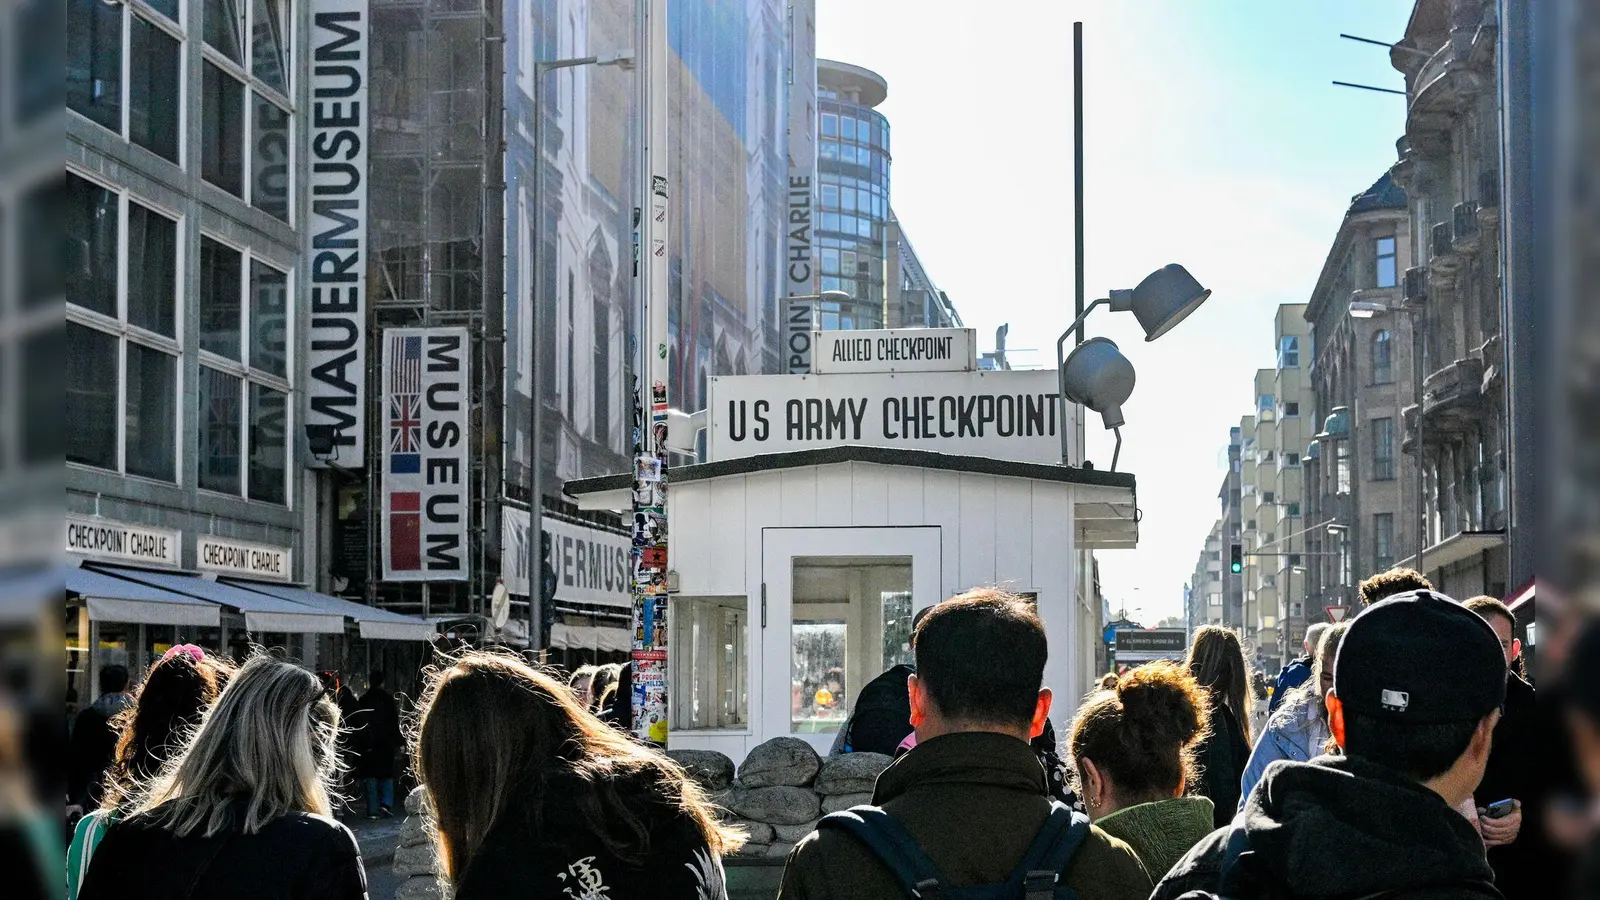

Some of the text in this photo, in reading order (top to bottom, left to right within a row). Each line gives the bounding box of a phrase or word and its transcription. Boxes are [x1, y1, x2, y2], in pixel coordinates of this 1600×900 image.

[311, 11, 361, 446] MAUERMUSEUM
[789, 175, 811, 284] CHARLIE
[832, 336, 953, 362] ALLIED CHECKPOINT
[728, 393, 1060, 442] US ARMY CHECKPOINT
[425, 335, 461, 570] MUSEUM
[68, 523, 167, 559] CHECKPOINT CHARLIE
[203, 543, 281, 573] CHECKPOINT CHARLIE
